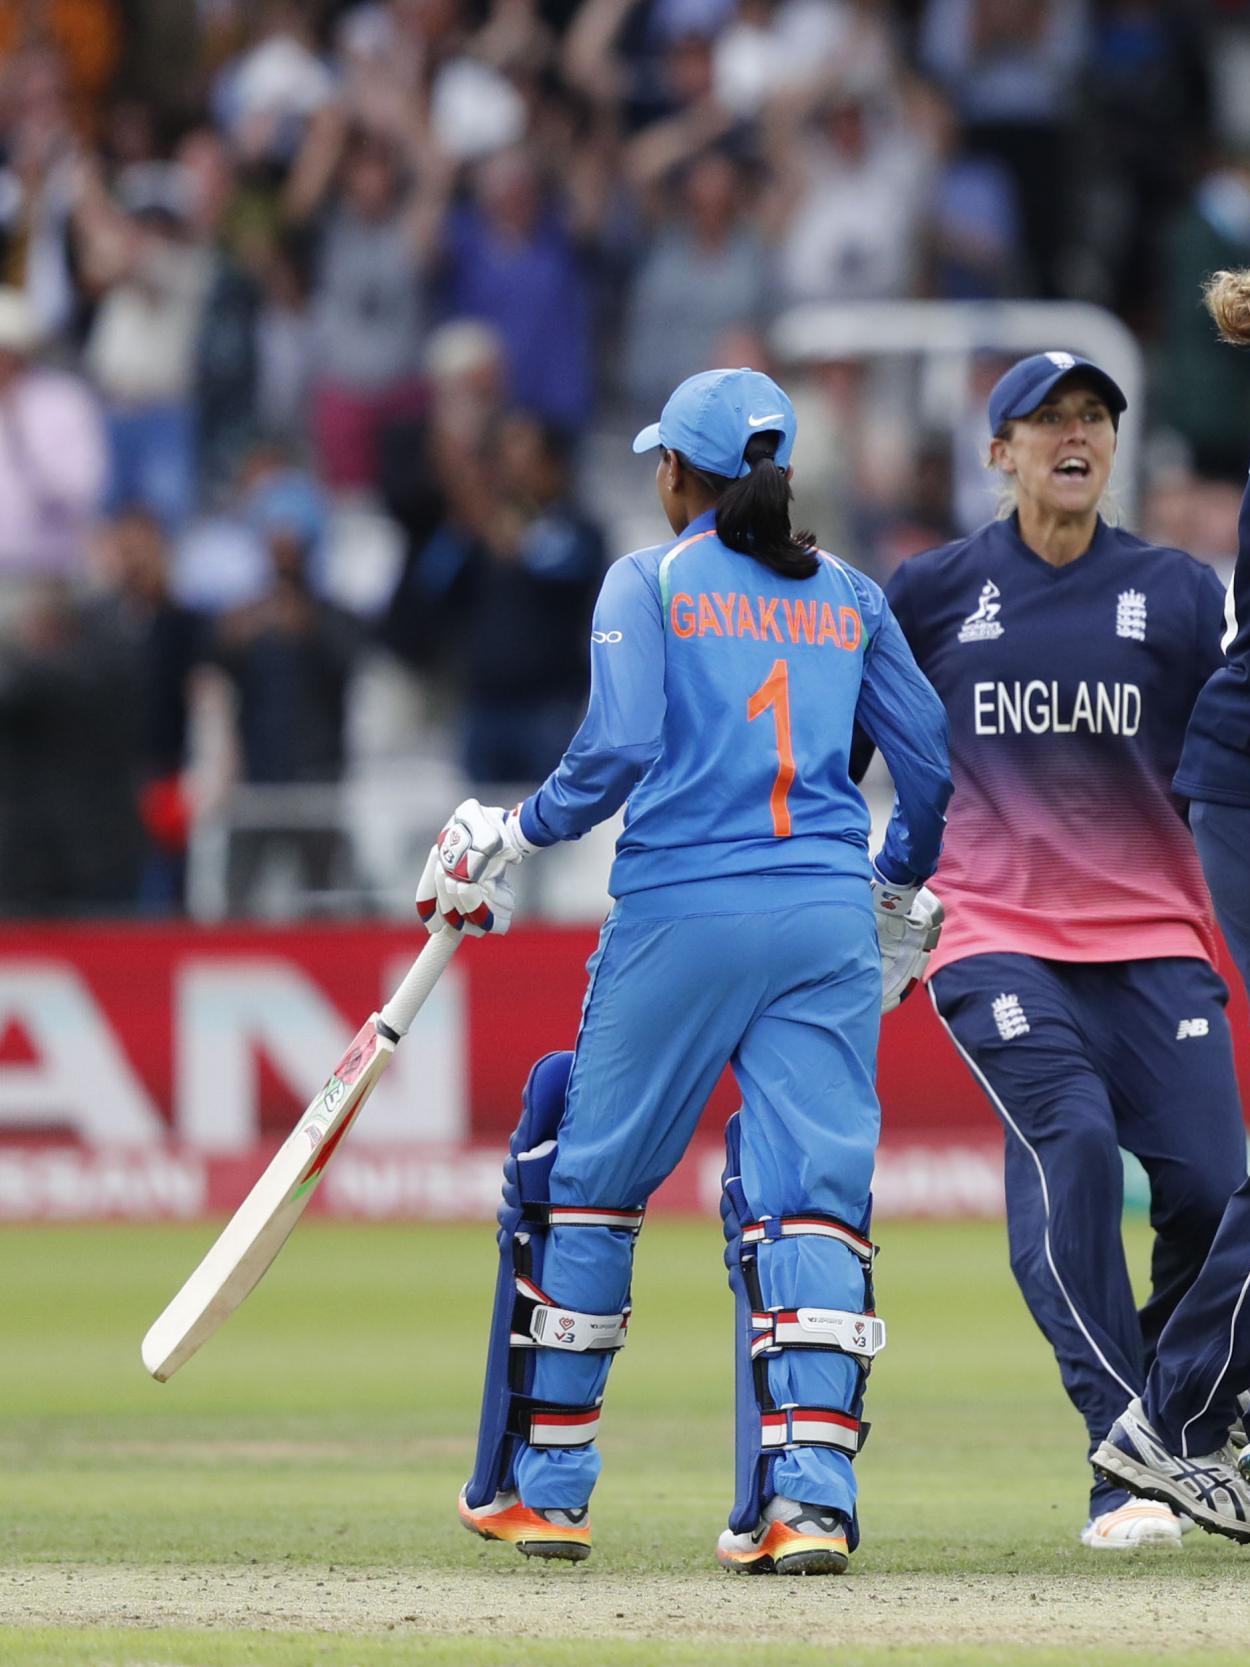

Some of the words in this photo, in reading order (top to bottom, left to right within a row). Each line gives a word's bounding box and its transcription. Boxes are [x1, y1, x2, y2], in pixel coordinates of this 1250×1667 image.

[671, 591, 862, 652] GAYAKWAD
[973, 679, 1142, 737] ENGLAND
[746, 658, 797, 838] 1
[554, 1331, 576, 1344] V3
[852, 1335, 867, 1348] V3
